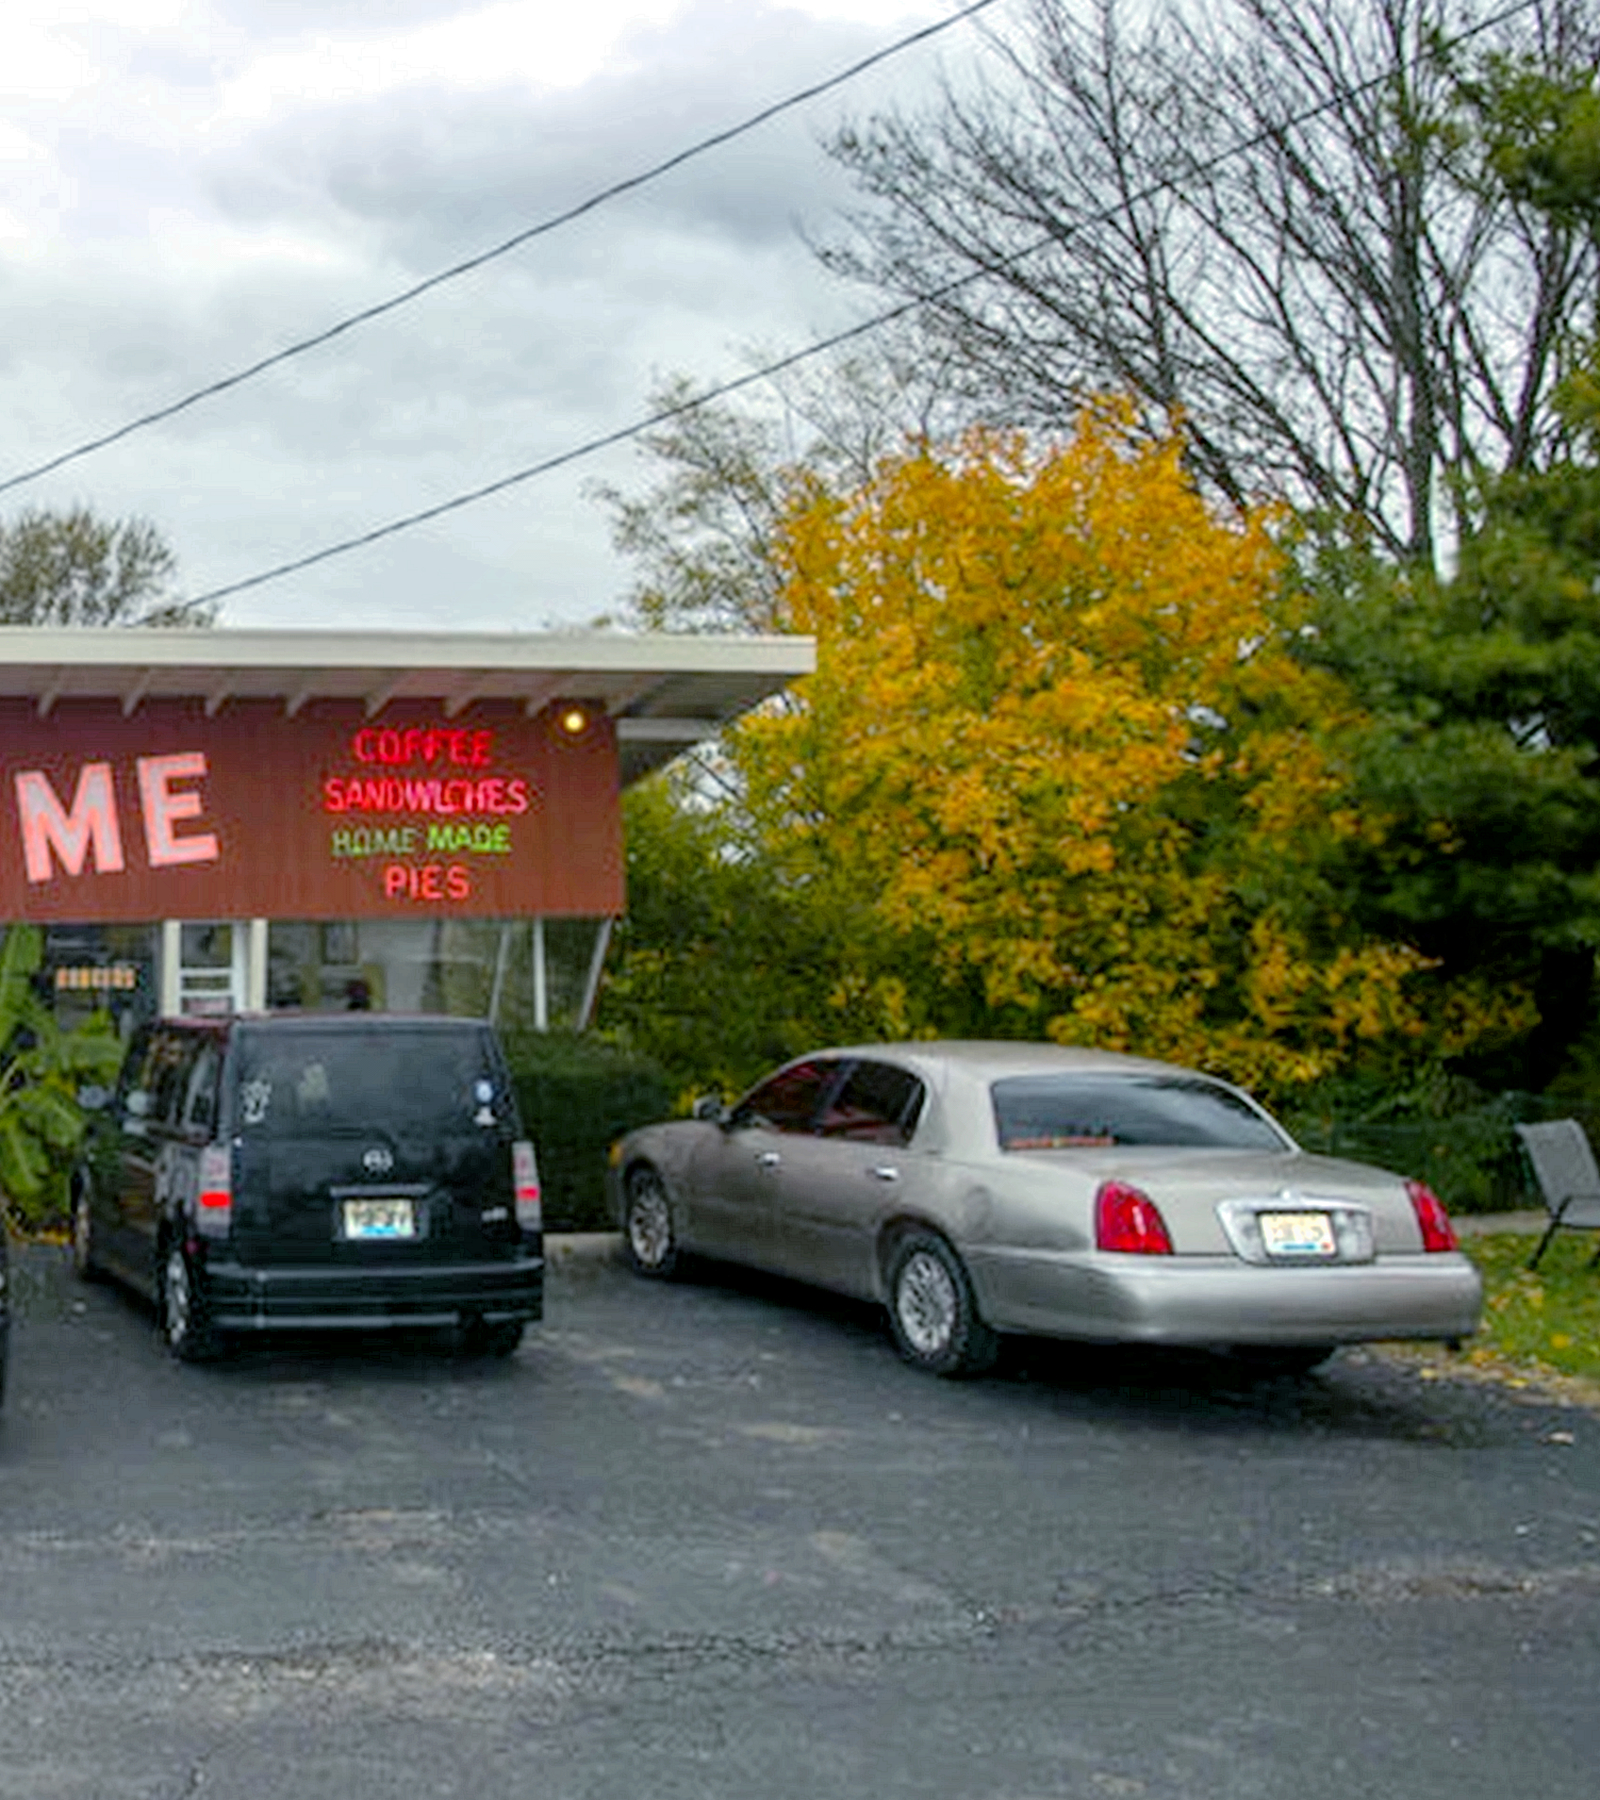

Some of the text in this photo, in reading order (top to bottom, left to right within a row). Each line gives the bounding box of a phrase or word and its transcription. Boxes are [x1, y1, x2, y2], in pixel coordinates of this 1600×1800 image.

[354, 728, 494, 765] COFFEE
[324, 777, 529, 814] SANDWICHES
[331, 822, 513, 857] HOME MADE
[384, 865, 470, 900] PIES
